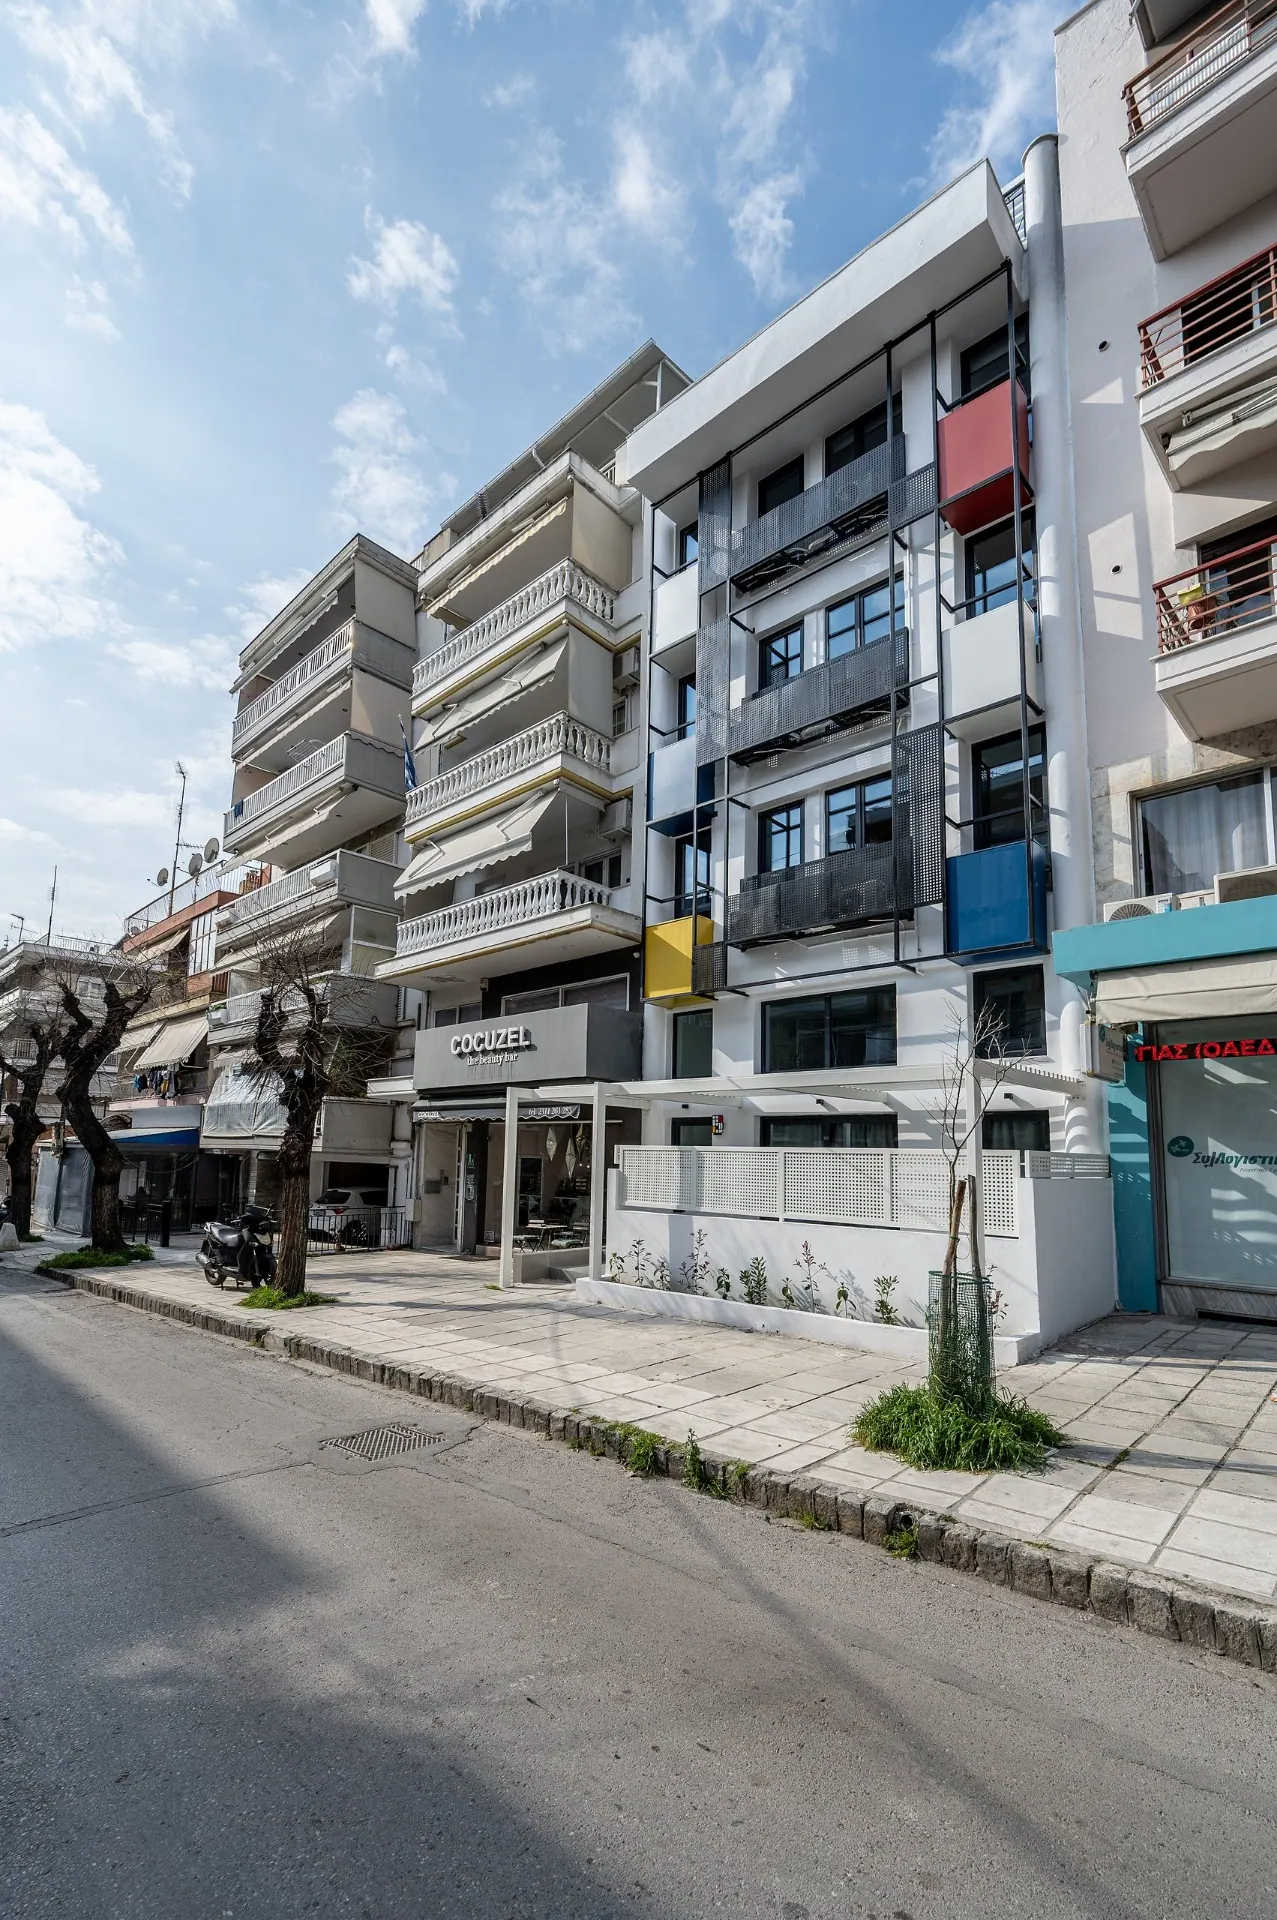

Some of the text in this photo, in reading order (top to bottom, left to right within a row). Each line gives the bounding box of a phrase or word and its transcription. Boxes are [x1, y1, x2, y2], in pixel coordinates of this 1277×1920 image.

[450, 1026, 531, 1055] COCUZEL
[1134, 1043, 1188, 1061] ΓΙΑΣ
[1195, 1038, 1277, 1059] (ΟΑΕΔ
[467, 1051, 518, 1066] the beauty bar
